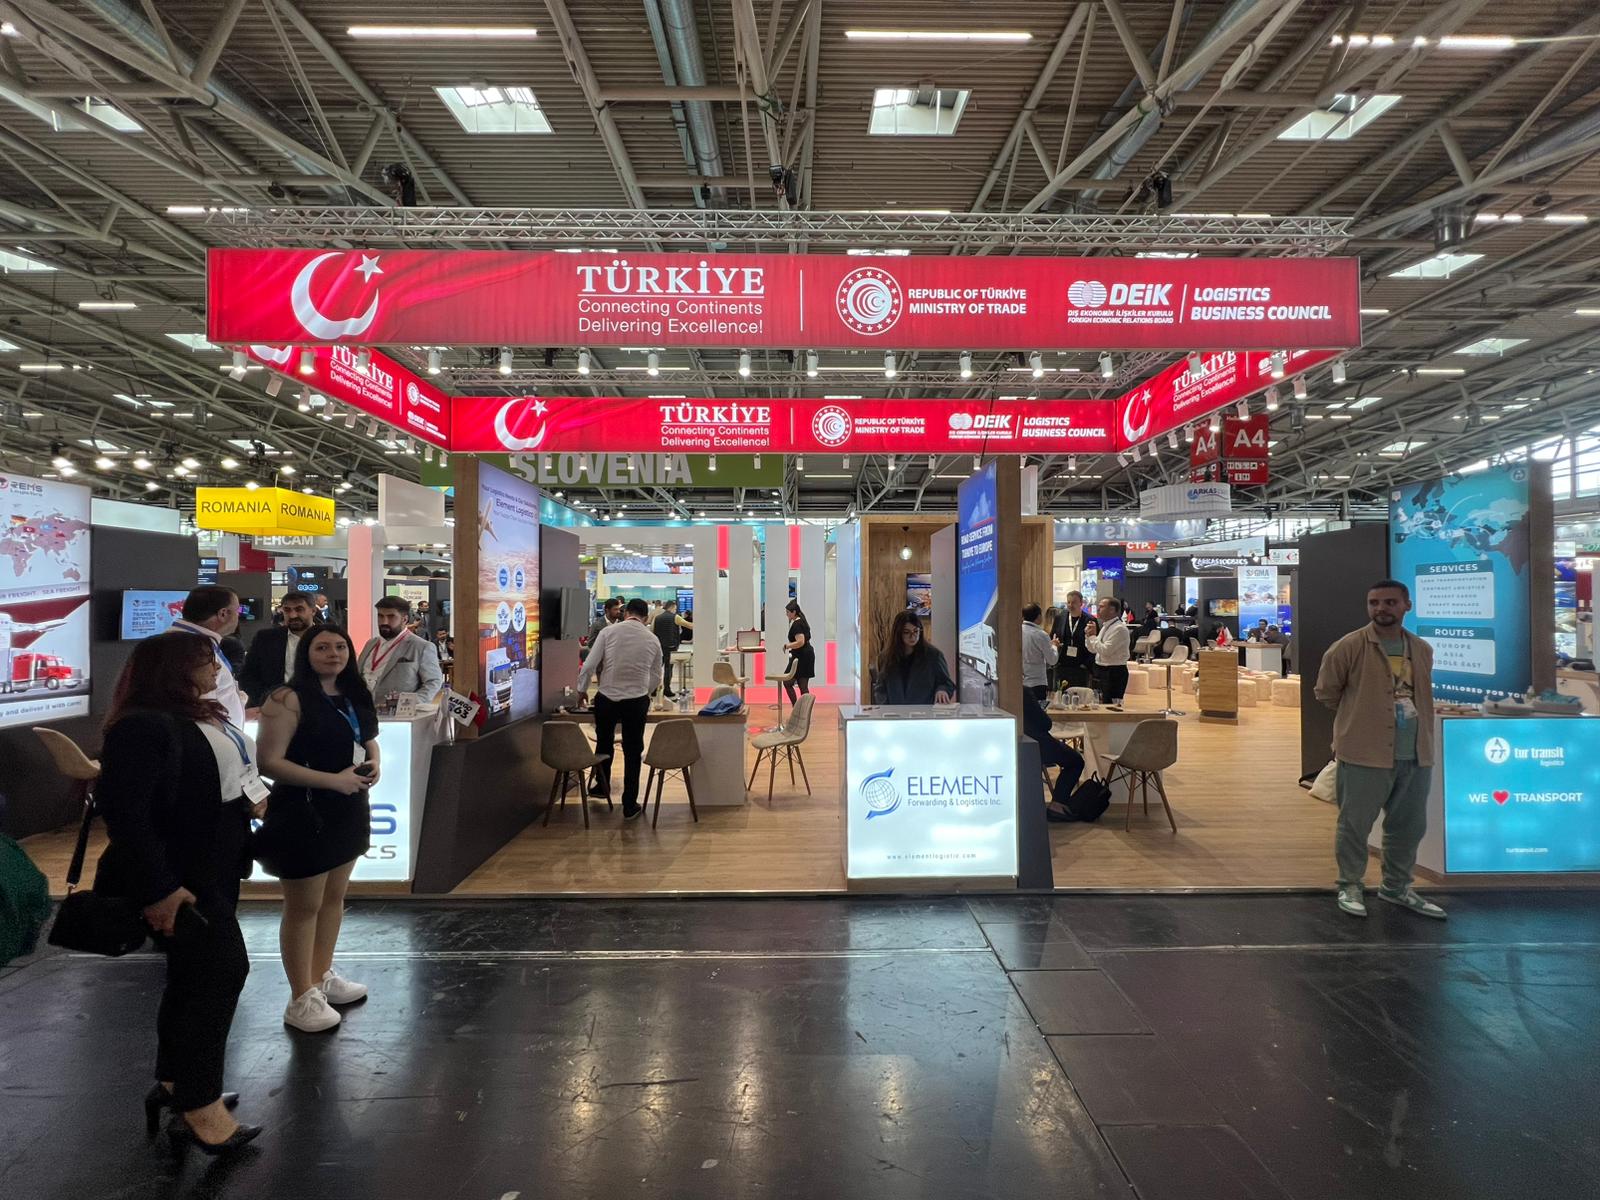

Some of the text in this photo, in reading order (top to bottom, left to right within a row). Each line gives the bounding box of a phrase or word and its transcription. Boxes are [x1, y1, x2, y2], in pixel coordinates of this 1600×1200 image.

[577, 260, 765, 294] TÜRKİYE
[908, 287, 1026, 299] REPUBLIC OF TÜRKİYE
[1193, 287, 1271, 302] LOGISTICS
[578, 299, 763, 317] Connecting Continents
[909, 303, 1027, 315] MINISTRY OF TRADE
[1191, 305, 1332, 321] BUSINESS COUNCIL
[578, 317, 763, 336] Delivering Excellence!
[660, 402, 771, 423] TÜRKİYE
[897, 416, 926, 425] TÜRKİYE
[1023, 417, 1070, 426] LOGISTICS
[661, 425, 770, 436] Connecting Continents
[855, 426, 926, 434] MINISTRY OF TRADE
[1022, 428, 1067, 438] BUSINESS
[1067, 428, 1107, 438] COUNCIL
[661, 436, 770, 448] Delivering Excellence!
[1196, 433, 1217, 456] A4
[1233, 429, 1266, 448] A4
[512, 453, 693, 484] SLOVENIA
[201, 501, 332, 523] ROMANIA ROMANIA
[254, 535, 314, 546] FERCAM
[1430, 563, 1478, 573] SERVICES
[1434, 628, 1475, 637] ROUTES
[1436, 642, 1472, 650] EUROPE
[1442, 684, 1483, 694] TAILORED
[1486, 689, 1504, 697] FOR
[448, 696, 473, 712] KARGO
[1514, 746, 1564, 758] tur transit
[907, 775, 1003, 796] ELEMENT
[907, 798, 948, 808] Forwarding
[949, 798, 954, 806] &
[955, 798, 988, 808] Logistics
[1469, 792, 1584, 803] WE TRANSPORT
